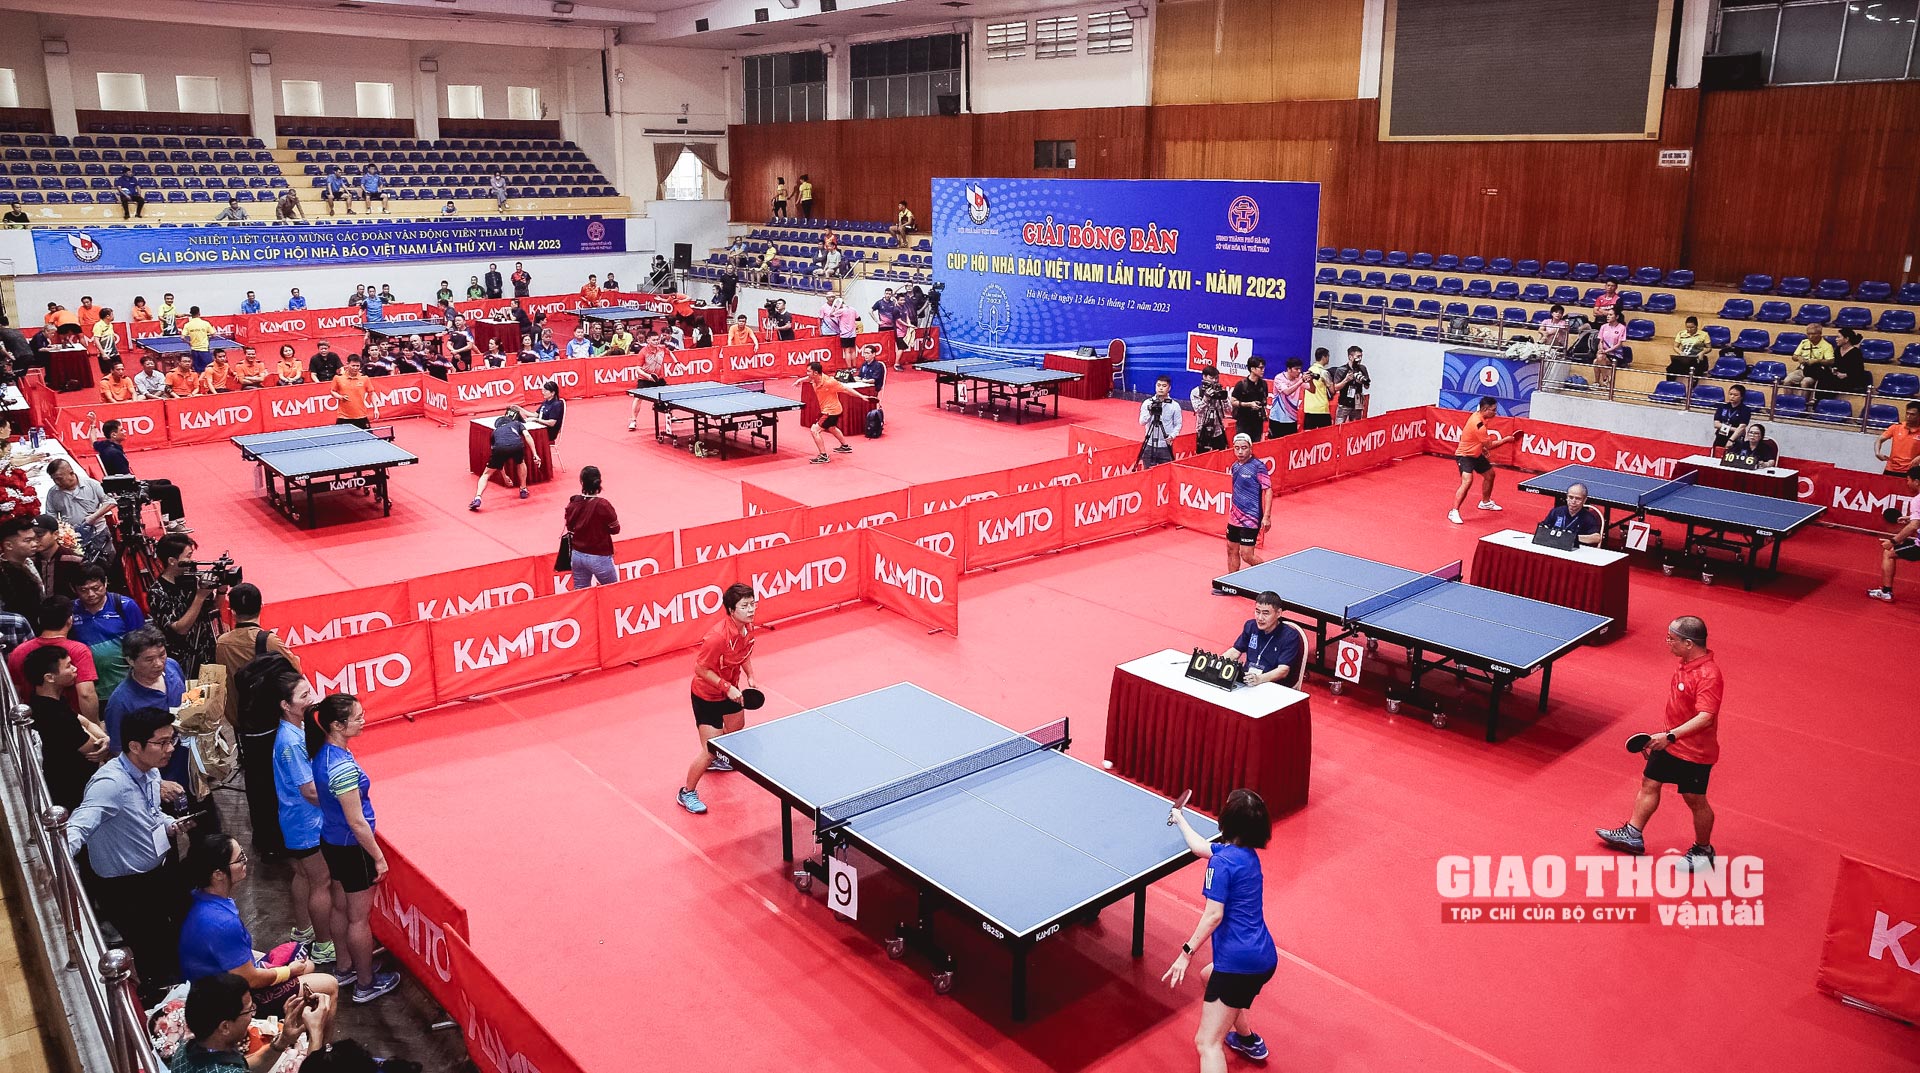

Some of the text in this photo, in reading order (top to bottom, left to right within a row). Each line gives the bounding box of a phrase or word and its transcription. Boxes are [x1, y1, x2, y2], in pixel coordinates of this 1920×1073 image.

[189, 227, 524, 245] NHIỆT LIỆT CHÀO MỪNG CÁC ĐOÀN VẬN ĐỘNG VIÊN THAM DỰ
[1022, 215, 1178, 254] GIẢI BÓNG BÀN
[139, 247, 171, 263] GIẢI
[175, 246, 218, 262] BÓNG
[222, 246, 250, 261] BÀN
[254, 246, 280, 260] CÚP
[285, 246, 308, 260] HỘI
[312, 244, 338, 258] NHÀ
[342, 244, 370, 257] BÁO
[372, 243, 396, 258] VIỆT
[399, 243, 427, 255] NAM
[430, 239, 452, 254] LẦN
[454, 239, 475, 253] THỨ
[478, 241, 496, 252] XVI
[510, 238, 535, 250] NĂM
[538, 239, 561, 250] 2023
[947, 250, 968, 270] CÚP
[970, 251, 988, 276] HỘI
[992, 253, 1015, 275] NHÀ
[1018, 254, 1042, 277] BÁO
[1045, 257, 1070, 283] VIỆT
[1073, 262, 1104, 282] NAM
[1107, 259, 1134, 286] LẦN
[1138, 263, 1166, 288] THỨ
[1168, 269, 1192, 290] XVI
[1205, 269, 1242, 296] NĂM
[1246, 276, 1287, 300] 2023
[529, 302, 566, 314] KAMITO
[646, 300, 674, 314] KAMITO
[1026, 289, 1036, 298] Hà
[1058, 294, 1074, 304] ngày
[1074, 294, 1082, 304] 13
[1084, 295, 1096, 305] đến
[1096, 296, 1105, 306] 15
[1106, 298, 1125, 310] tháng
[1126, 300, 1135, 310] 12
[1136, 302, 1152, 311] năm
[1152, 302, 1170, 313] 2023
[384, 312, 417, 323] AMITO
[458, 308, 484, 321] MITO
[260, 320, 306, 334] KAMITO
[663, 359, 713, 378] KAMITO
[730, 352, 775, 371] KAMITO
[788, 348, 832, 366] KAMITO
[1193, 357, 1213, 366] KAMITO
[523, 370, 579, 390] KAMITO
[1486, 371, 1492, 382] 1
[426, 388, 448, 411] KAMITO
[458, 379, 515, 401] KAMITO
[960, 386, 966, 400] 4
[179, 405, 252, 430] KAMITO
[272, 394, 338, 418] KAMITO
[70, 416, 154, 440] KATO
[738, 420, 762, 430] KAMITO
[1346, 430, 1386, 456] KAMITO
[1522, 433, 1596, 462] KAMITO
[1288, 442, 1332, 470] KAMITO
[1614, 450, 1678, 478] KAMIT
[1725, 452, 1734, 462] 10
[1746, 456, 1754, 464] 6
[330, 477, 366, 492] KAMITO
[1074, 490, 1142, 528] KAMITO
[1832, 486, 1913, 517] KAMIT
[978, 507, 1053, 546] KAMITO
[1632, 525, 1648, 548] 7
[752, 556, 847, 602] KAMITO
[875, 553, 945, 604] KAMITO
[614, 584, 724, 639] KAMITO
[271, 611, 393, 648] AMITO
[454, 618, 580, 674] KAMITO
[1194, 655, 1234, 680] 0 1 0 0
[1339, 645, 1361, 679] 8
[1490, 664, 1510, 674] 6825P
[835, 871, 852, 907] 9
[374, 882, 451, 983] AMITO
[982, 922, 1004, 940] 6825P
[1035, 924, 1060, 942] KAMITO
